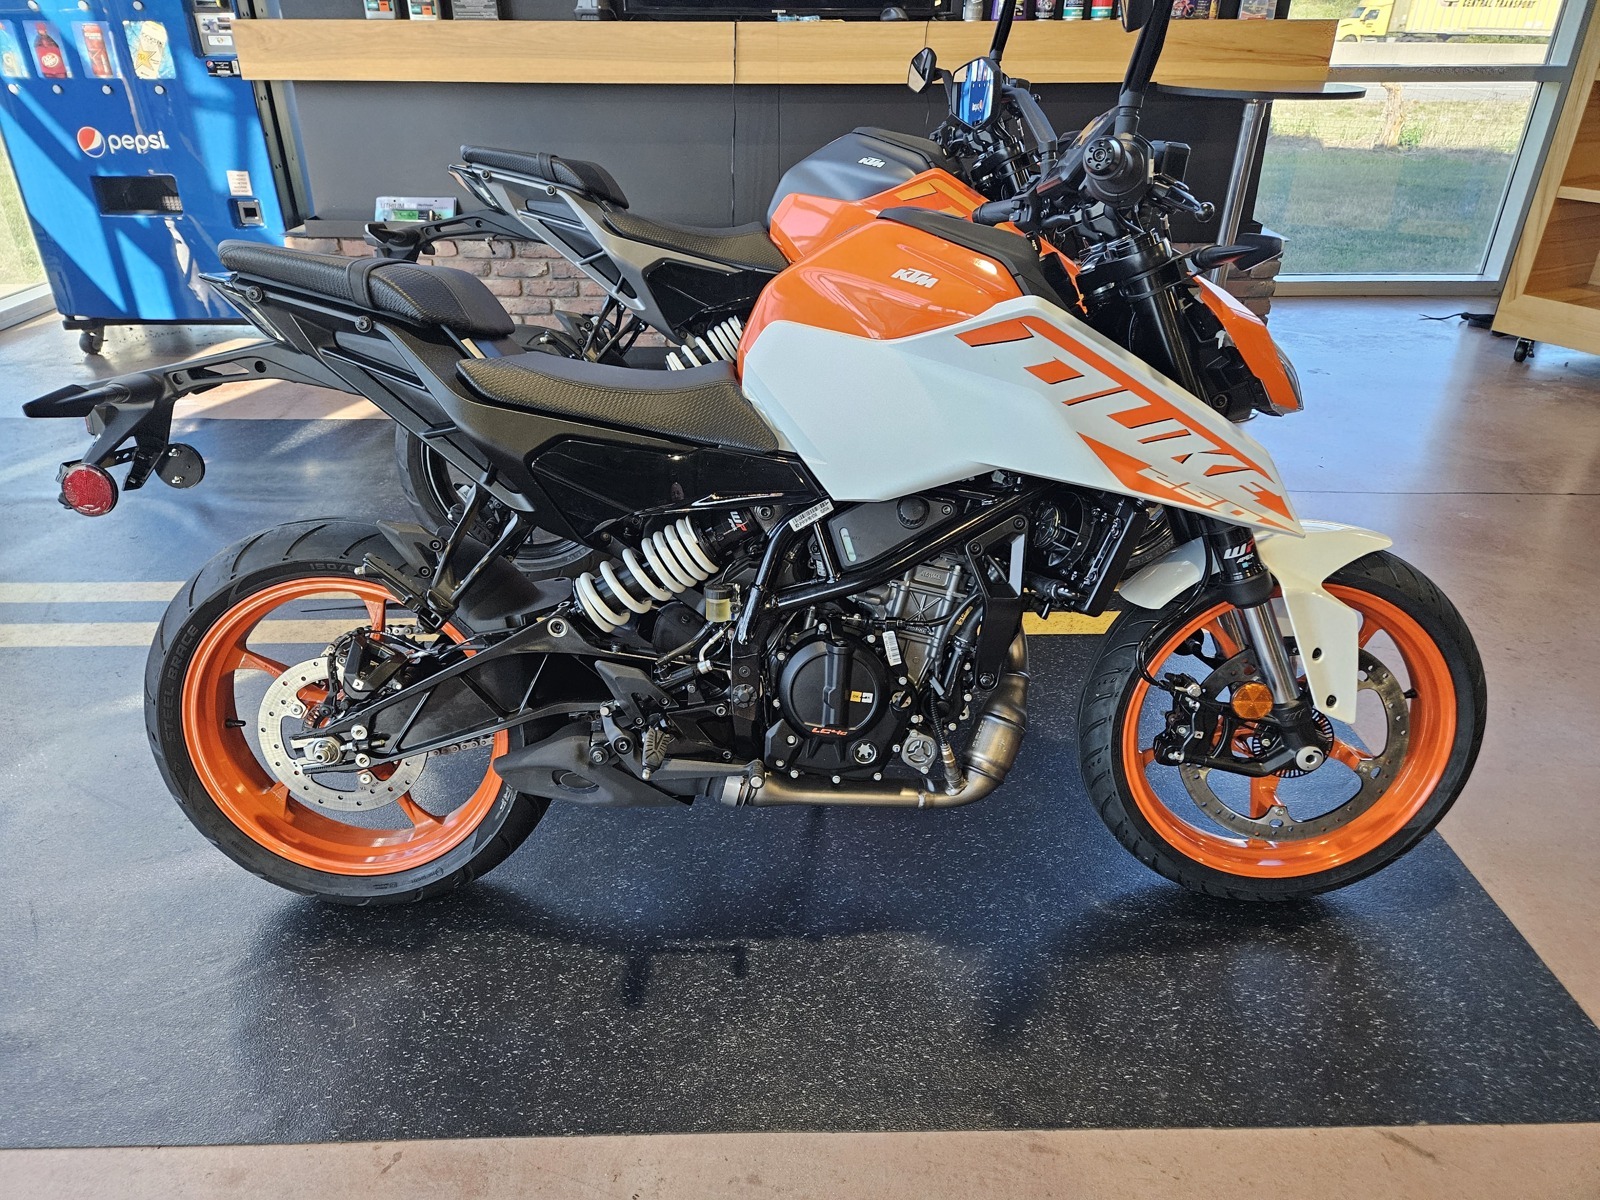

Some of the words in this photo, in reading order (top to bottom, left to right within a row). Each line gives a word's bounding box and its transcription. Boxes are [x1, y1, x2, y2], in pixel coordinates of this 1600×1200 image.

[858, 157, 886, 168] KTM
[890, 267, 939, 289] KTM
[167, 624, 199, 681] BRACE
[162, 687, 176, 742] STEEL
